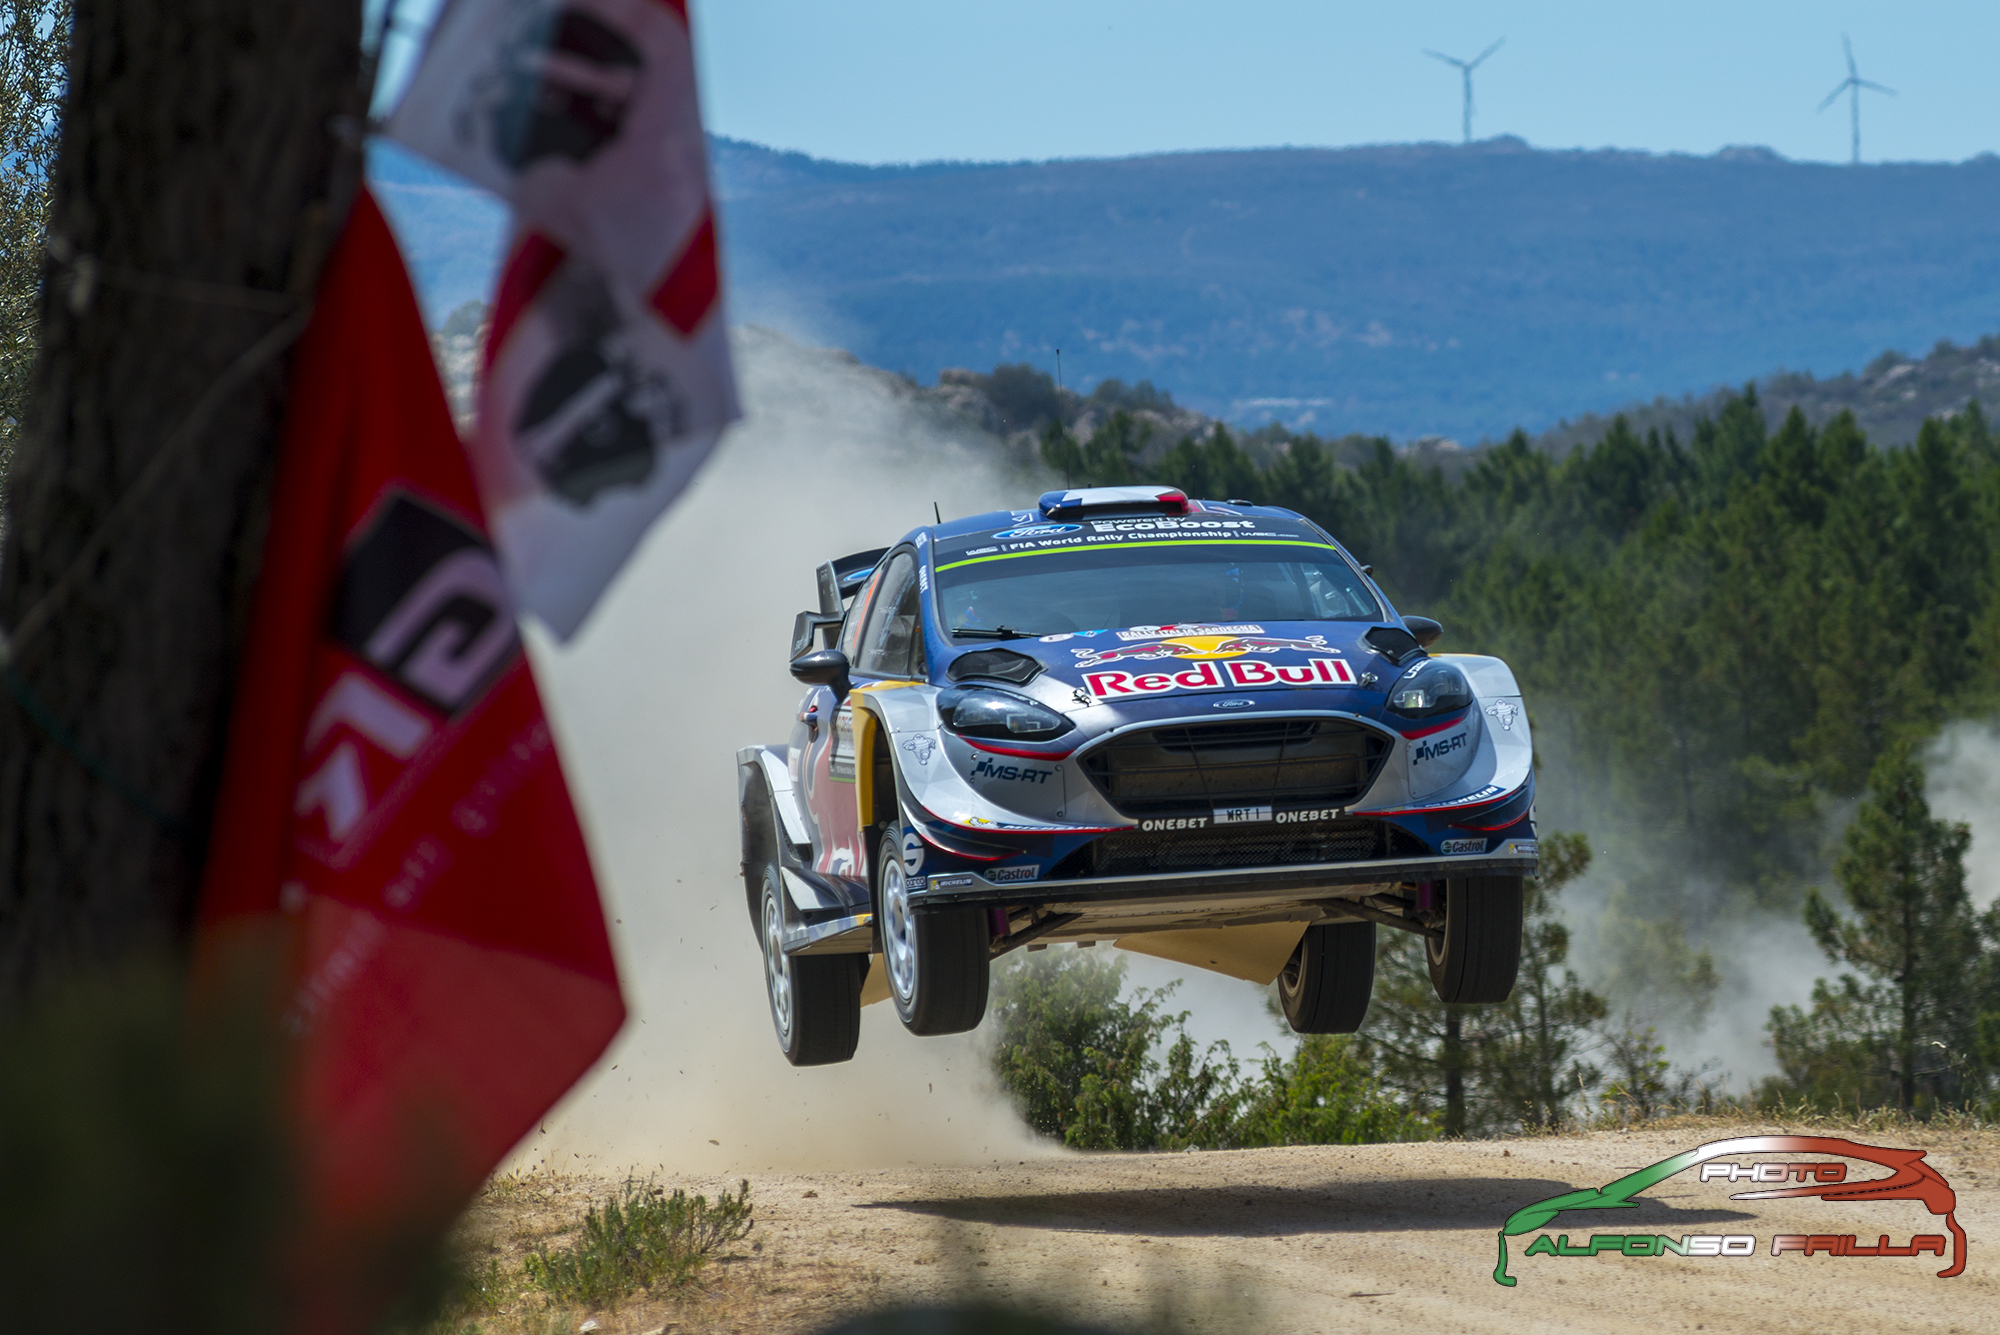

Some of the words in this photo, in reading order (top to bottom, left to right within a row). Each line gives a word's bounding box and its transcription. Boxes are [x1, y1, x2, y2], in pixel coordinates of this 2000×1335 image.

[1009, 525, 1067, 539] Ford
[1093, 520, 1255, 533] EcoBoost
[1009, 542, 1036, 550] FIA
[1038, 535, 1083, 547] World
[1086, 532, 1124, 544] Rally
[1128, 530, 1231, 540] Championship
[1122, 628, 1158, 639] RALLY
[1085, 662, 1222, 697] Red
[1228, 659, 1353, 685] Bull
[1425, 732, 1467, 761] MS-RT
[983, 764, 1053, 784] MS-RT
[1226, 809, 1251, 822] WRT
[1275, 808, 1340, 824] ONEBET
[1142, 817, 1208, 832] ONEBET
[1452, 839, 1485, 853] Castrol
[997, 866, 1036, 881] Castrol
[940, 878, 973, 887] MICHELIN
